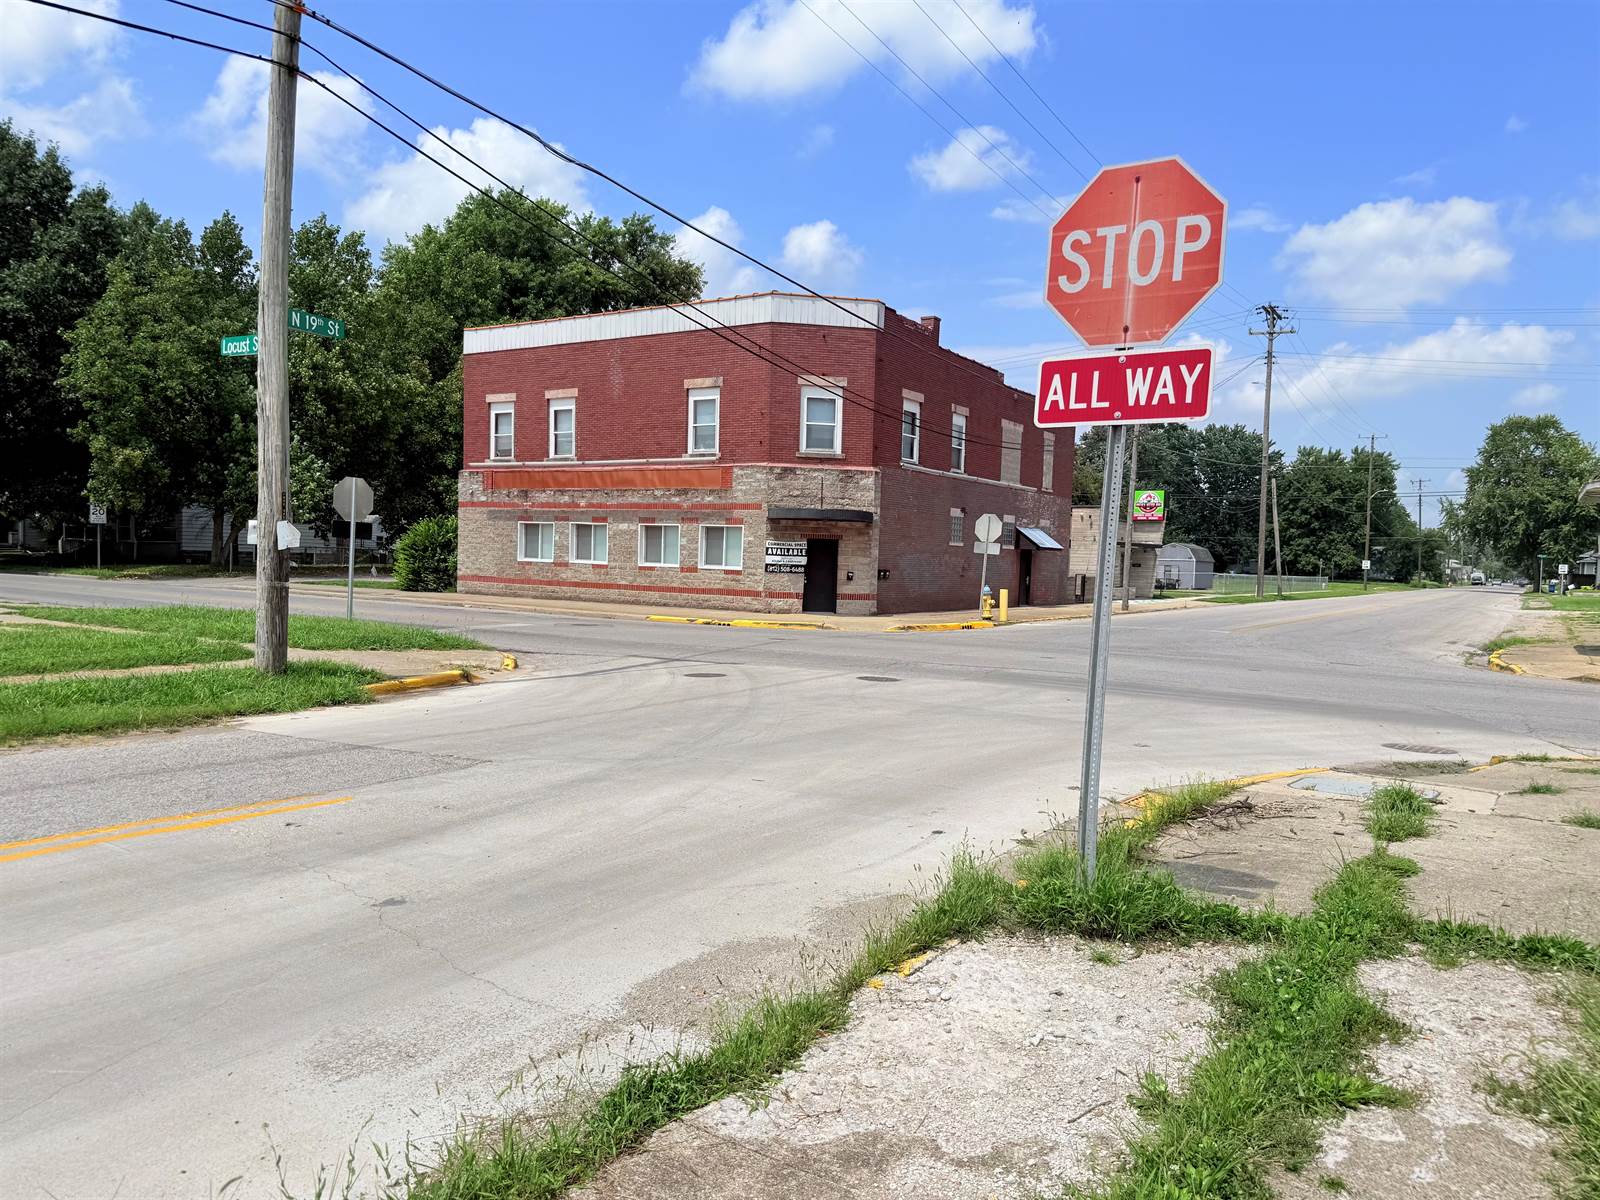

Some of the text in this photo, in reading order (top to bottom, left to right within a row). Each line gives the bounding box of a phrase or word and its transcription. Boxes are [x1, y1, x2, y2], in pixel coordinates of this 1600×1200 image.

[1057, 213, 1212, 294] STOP
[291, 311, 340, 336] N 19th St
[222, 336, 259, 354] Locust S
[1043, 363, 1204, 411] ALL WAY
